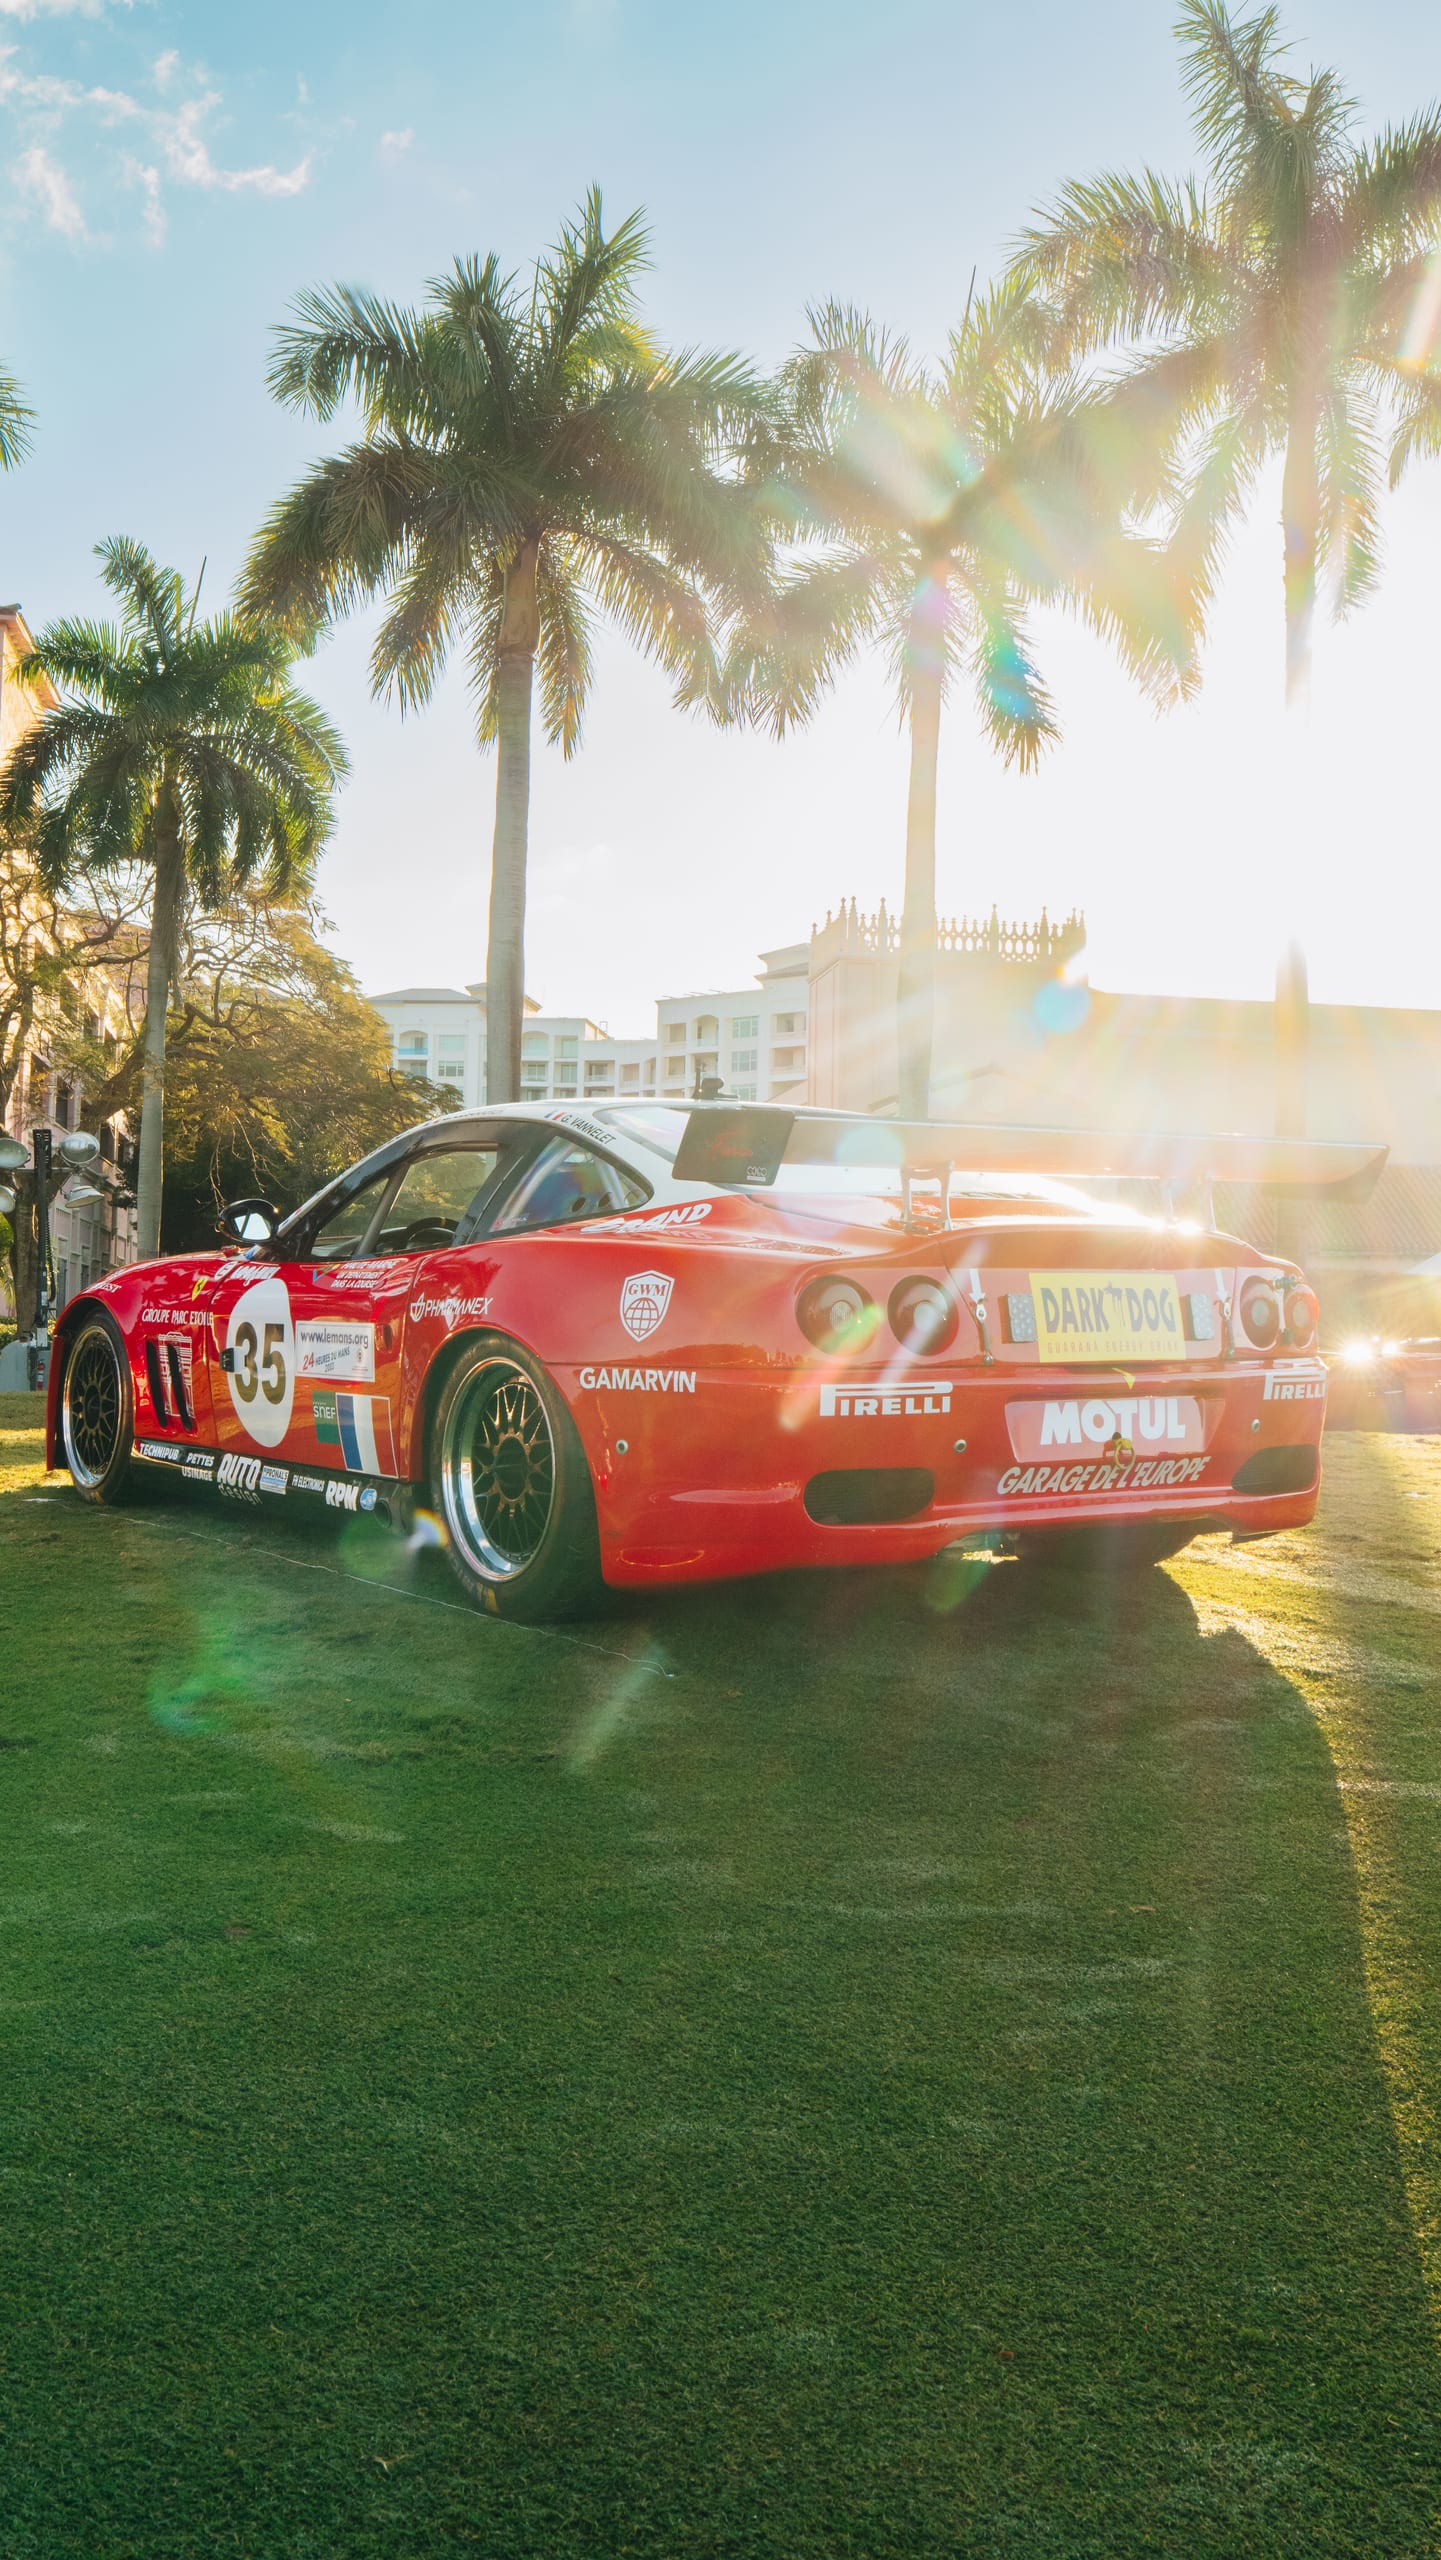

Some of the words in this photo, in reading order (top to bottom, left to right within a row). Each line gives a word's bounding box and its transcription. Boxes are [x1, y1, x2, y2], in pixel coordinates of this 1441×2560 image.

[572, 1117, 617, 1145] VANNELET
[579, 1202, 713, 1235] GRAND
[627, 1283, 667, 1297] GWM
[141, 1308, 171, 1323] GROUPE
[171, 1309, 189, 1325] PARC
[189, 1311, 214, 1326] ETOILE
[424, 1296, 494, 1318] PHARMANEX
[1040, 1287, 1110, 1334] DARK
[1125, 1287, 1177, 1333] DOG
[300, 1327, 369, 1349] www.lemans.org
[1047, 1341, 1100, 1355] GUARANA
[234, 1321, 287, 1406] 35
[302, 1352, 315, 1371] 24
[579, 1366, 697, 1393] GAMARVIN
[1262, 1369, 1327, 1401] PIRELLI
[819, 1381, 954, 1417] PIRELLI
[1039, 1398, 1187, 1446] MOTUL
[139, 1443, 180, 1461] TECHNIPUB
[185, 1452, 215, 1467] PETTES
[216, 1452, 262, 1491] AUTO
[996, 1464, 1097, 1495] GARAGE
[1089, 1464, 1119, 1491] DE
[325, 1480, 360, 1512] RPM
